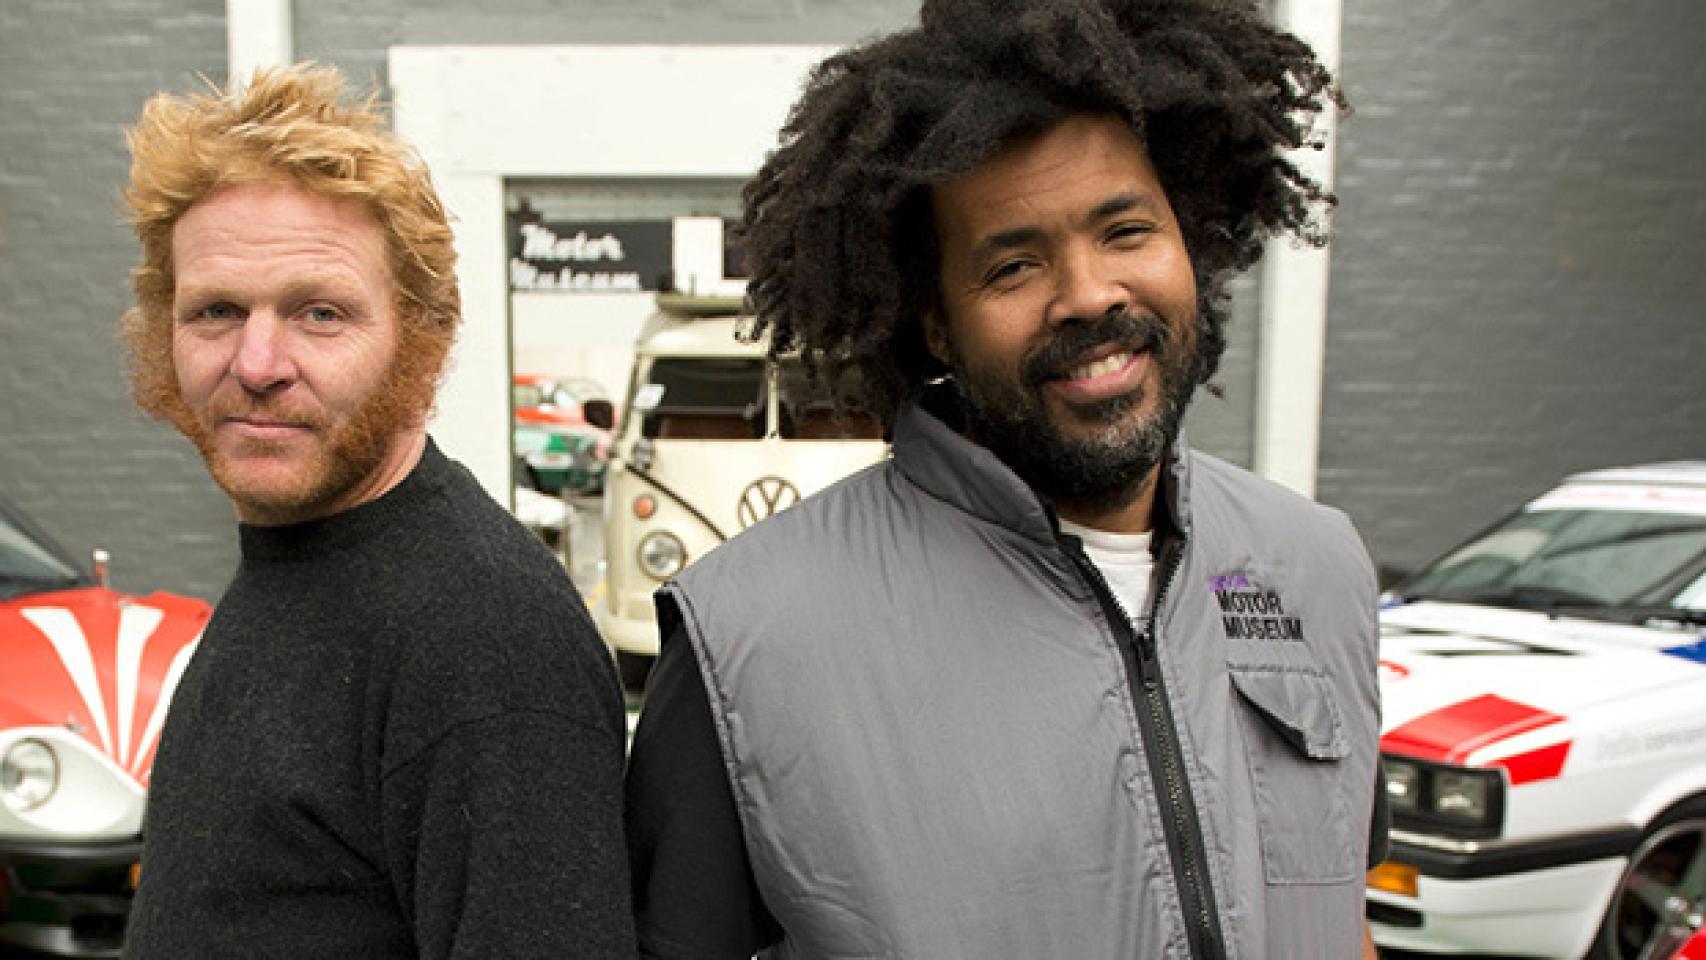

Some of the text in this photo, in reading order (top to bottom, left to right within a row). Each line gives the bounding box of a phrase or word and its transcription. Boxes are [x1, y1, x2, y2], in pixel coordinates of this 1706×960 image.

[521, 224, 623, 260] Motor
[1215, 589, 1284, 615] MOTOR
[1223, 616, 1304, 642] MUSEUM
